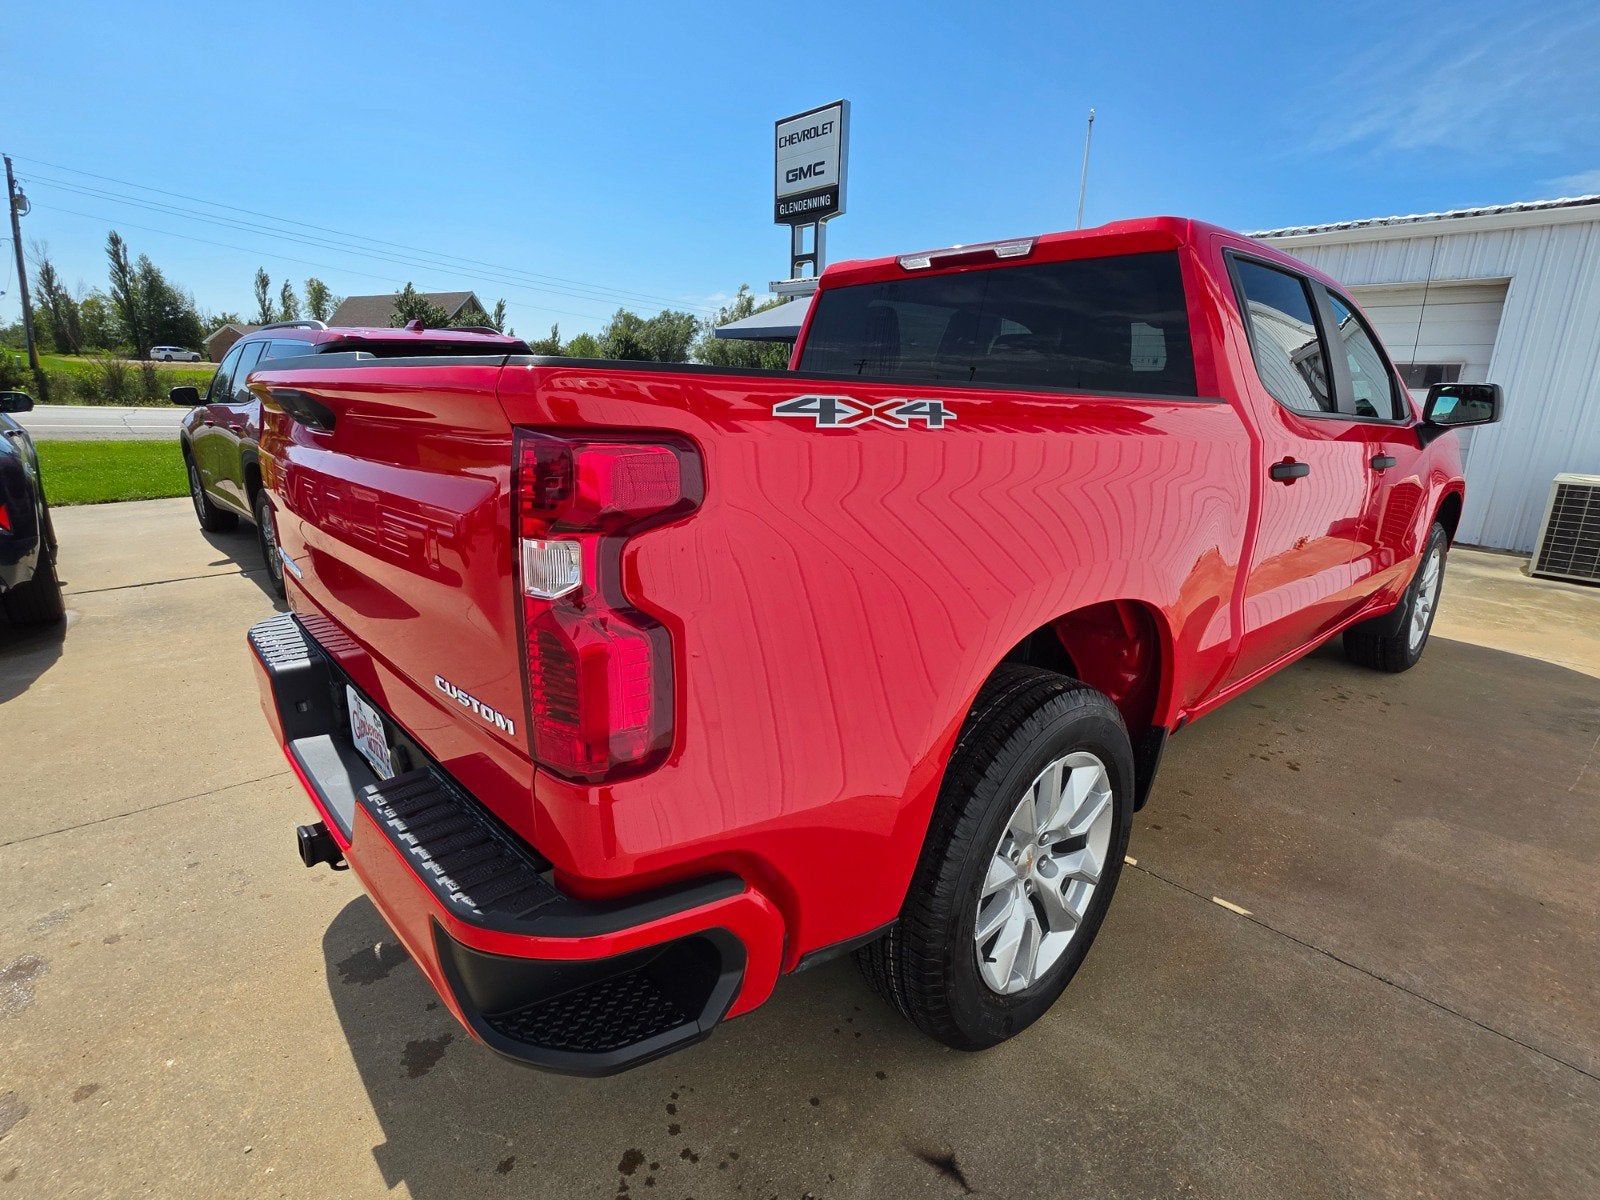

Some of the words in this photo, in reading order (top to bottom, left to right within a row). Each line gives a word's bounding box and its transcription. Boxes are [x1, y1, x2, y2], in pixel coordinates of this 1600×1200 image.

[779, 121, 834, 148] CHEVROLET
[786, 161, 825, 183] GMC
[780, 195, 831, 215] GLENDENNING
[434, 674, 515, 736] CUSTOM
